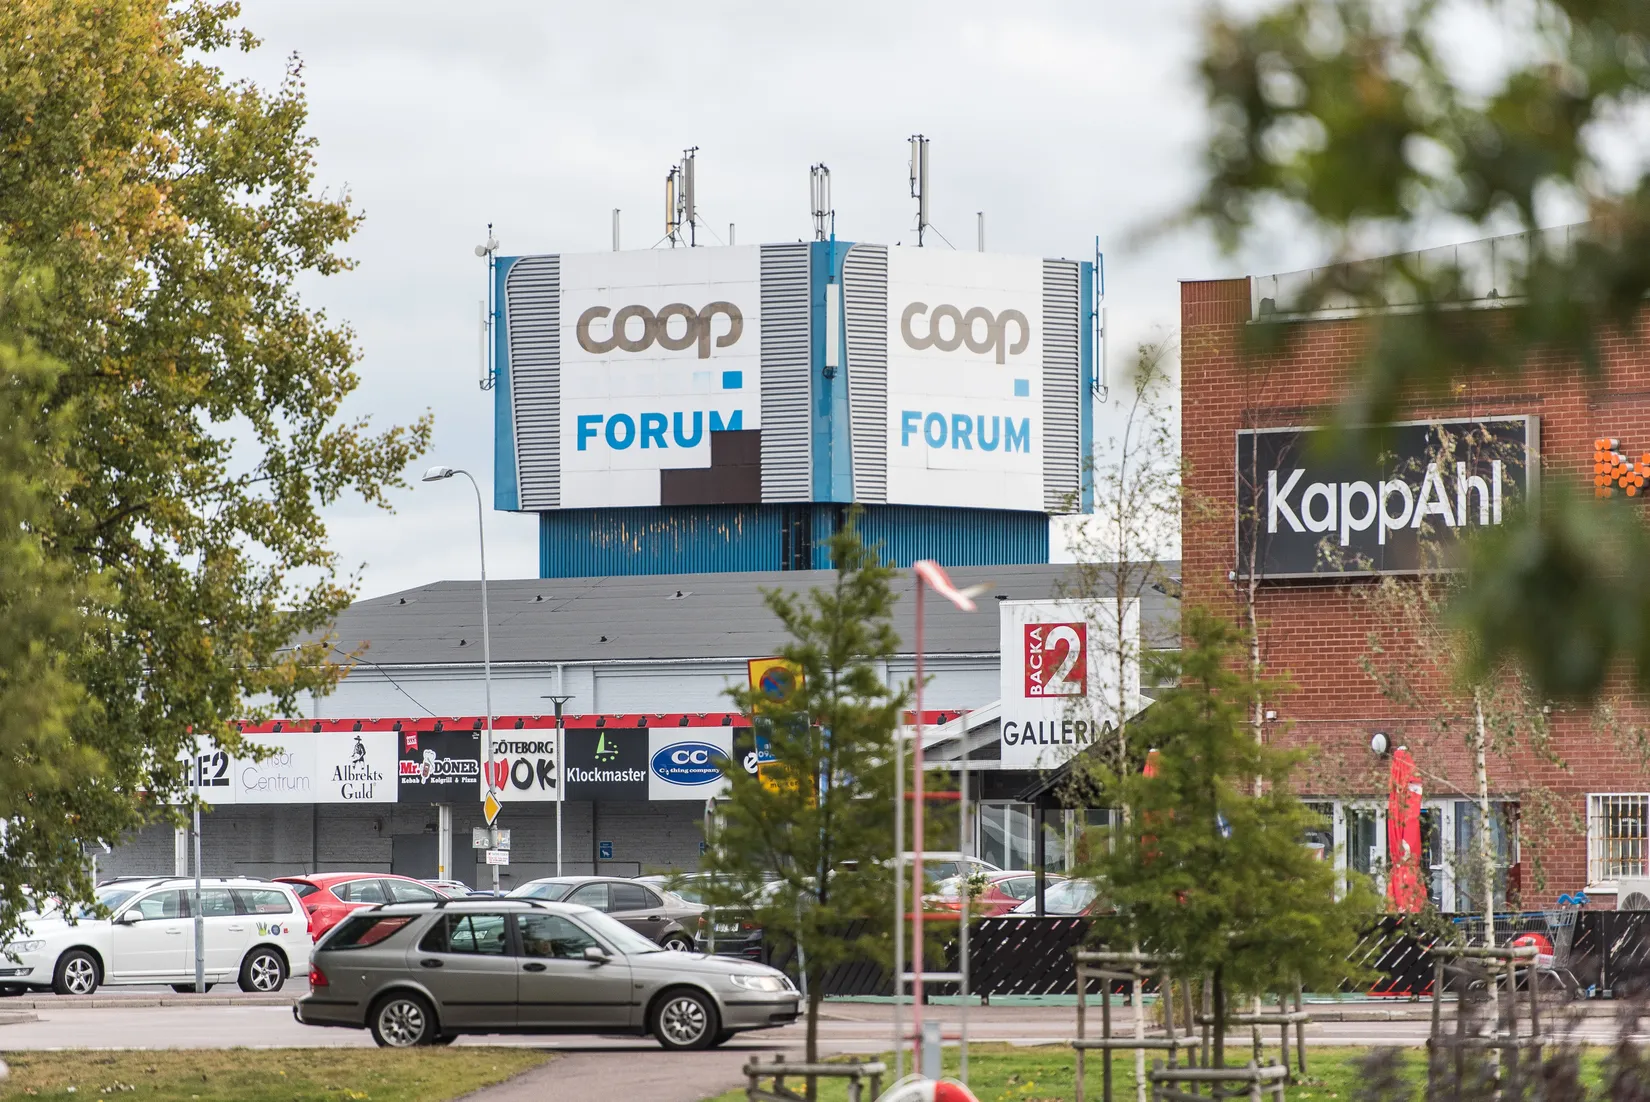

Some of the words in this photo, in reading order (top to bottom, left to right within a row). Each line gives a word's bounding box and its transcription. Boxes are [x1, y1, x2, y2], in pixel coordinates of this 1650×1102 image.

[576, 301, 743, 359] coop
[900, 301, 1030, 365] coop
[577, 410, 743, 451] FORUM
[901, 411, 1031, 453] FORUM
[1267, 459, 1502, 546] KappAhl
[1029, 626, 1043, 696] BACKA
[1043, 625, 1082, 695] 2
[492, 740, 553, 754] GÖTEBORG
[671, 750, 708, 764] CC
[242, 766, 310, 790] Centrum
[331, 764, 383, 781] Albrekts
[400, 762, 420, 774] Mr.
[434, 758, 477, 774] DÖNER
[484, 757, 556, 791] WOK
[567, 767, 646, 783] Klockmaster
[341, 783, 373, 799] Guld
